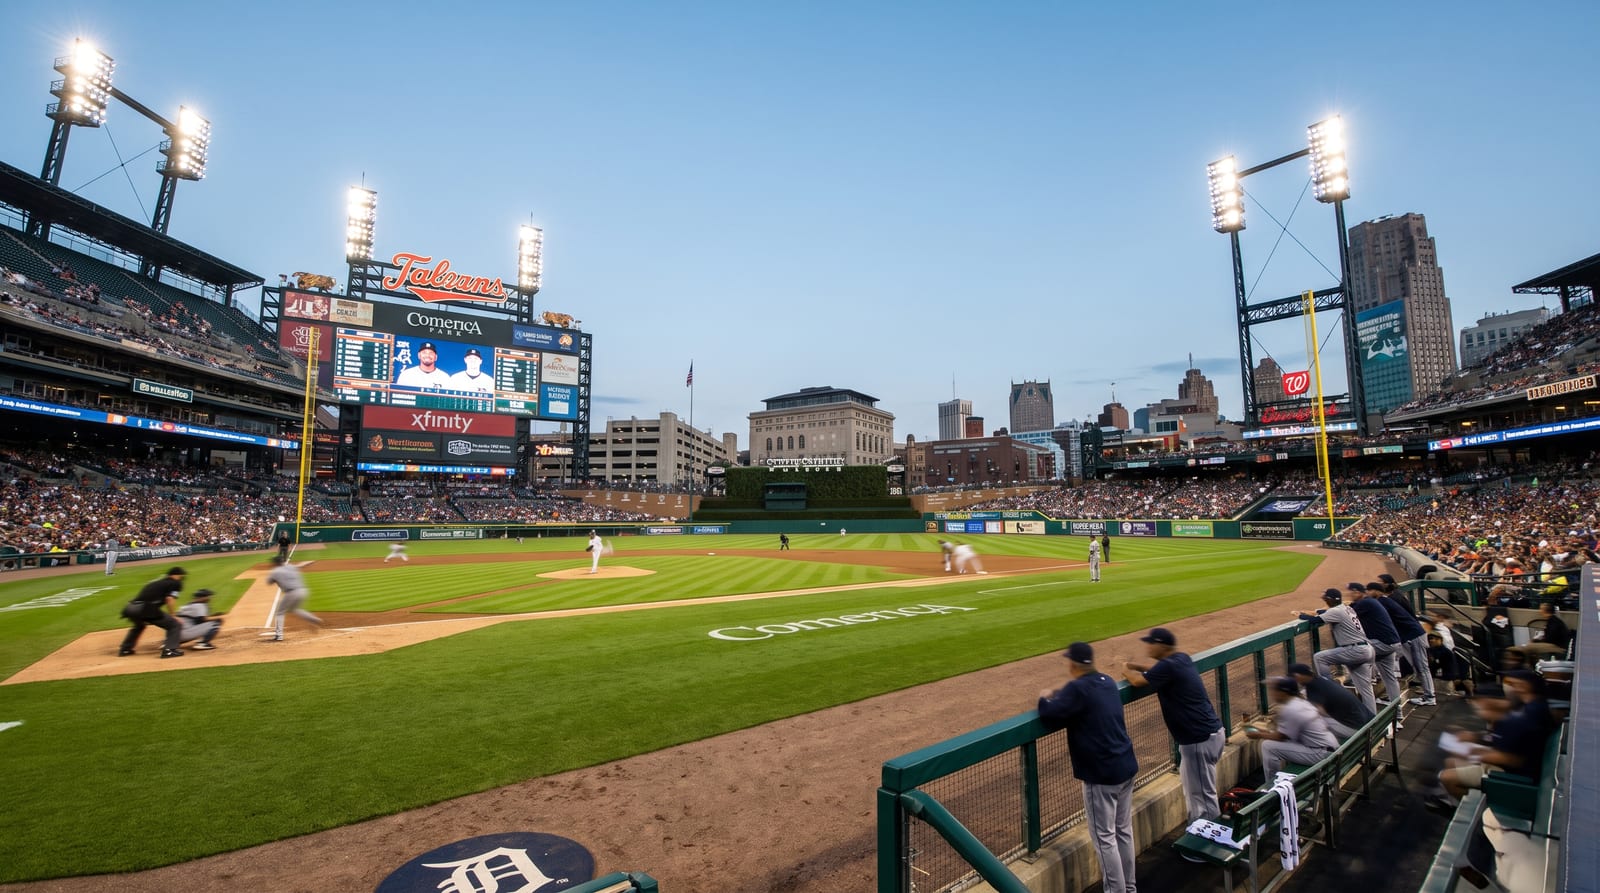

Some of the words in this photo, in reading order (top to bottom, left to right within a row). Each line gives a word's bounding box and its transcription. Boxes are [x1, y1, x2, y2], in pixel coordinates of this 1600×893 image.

[429, 328, 462, 337] PARK
[1285, 373, 1307, 393] W
[411, 411, 473, 433] xfinity
